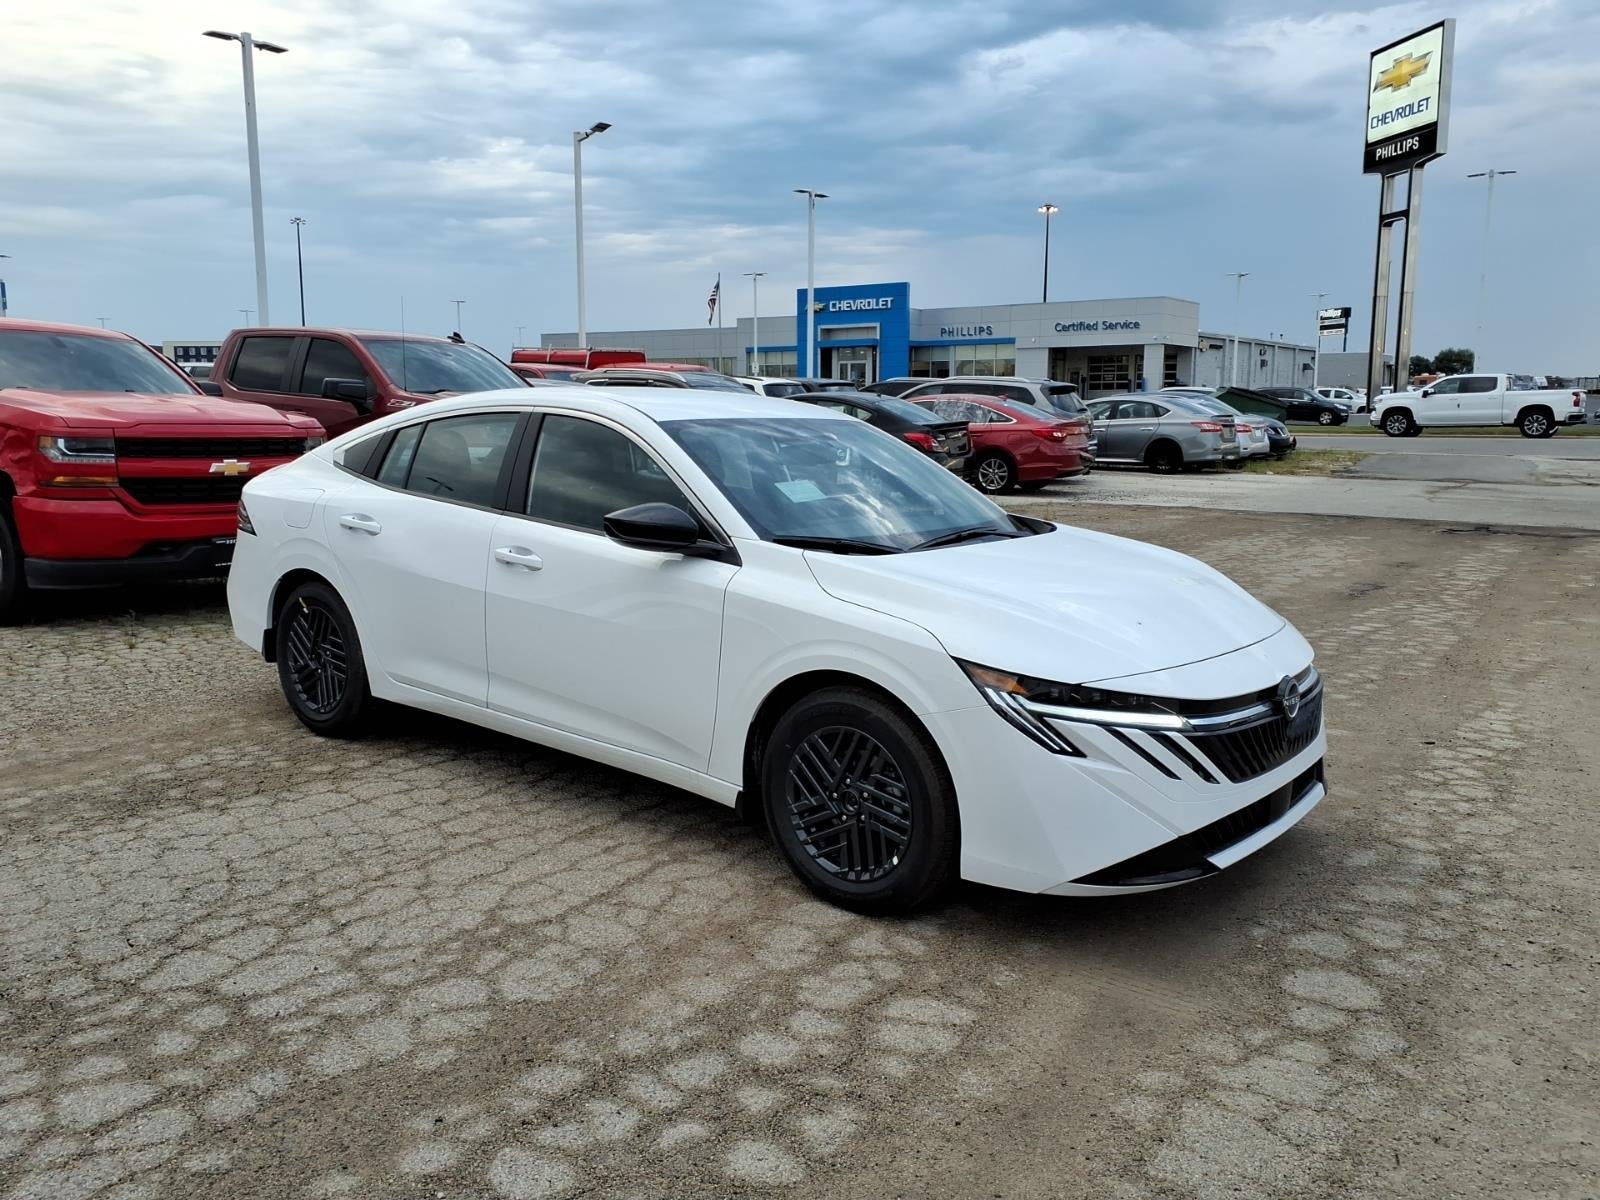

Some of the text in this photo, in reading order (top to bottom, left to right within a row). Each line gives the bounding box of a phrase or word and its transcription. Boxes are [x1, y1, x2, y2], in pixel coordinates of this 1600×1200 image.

[1370, 96, 1432, 130] CHEVROLET
[1375, 136, 1420, 161] PHILLIPS
[829, 297, 894, 312] CHEVROLET
[940, 325, 993, 337] PHILLIPS
[1054, 319, 1140, 333] Certified Service
